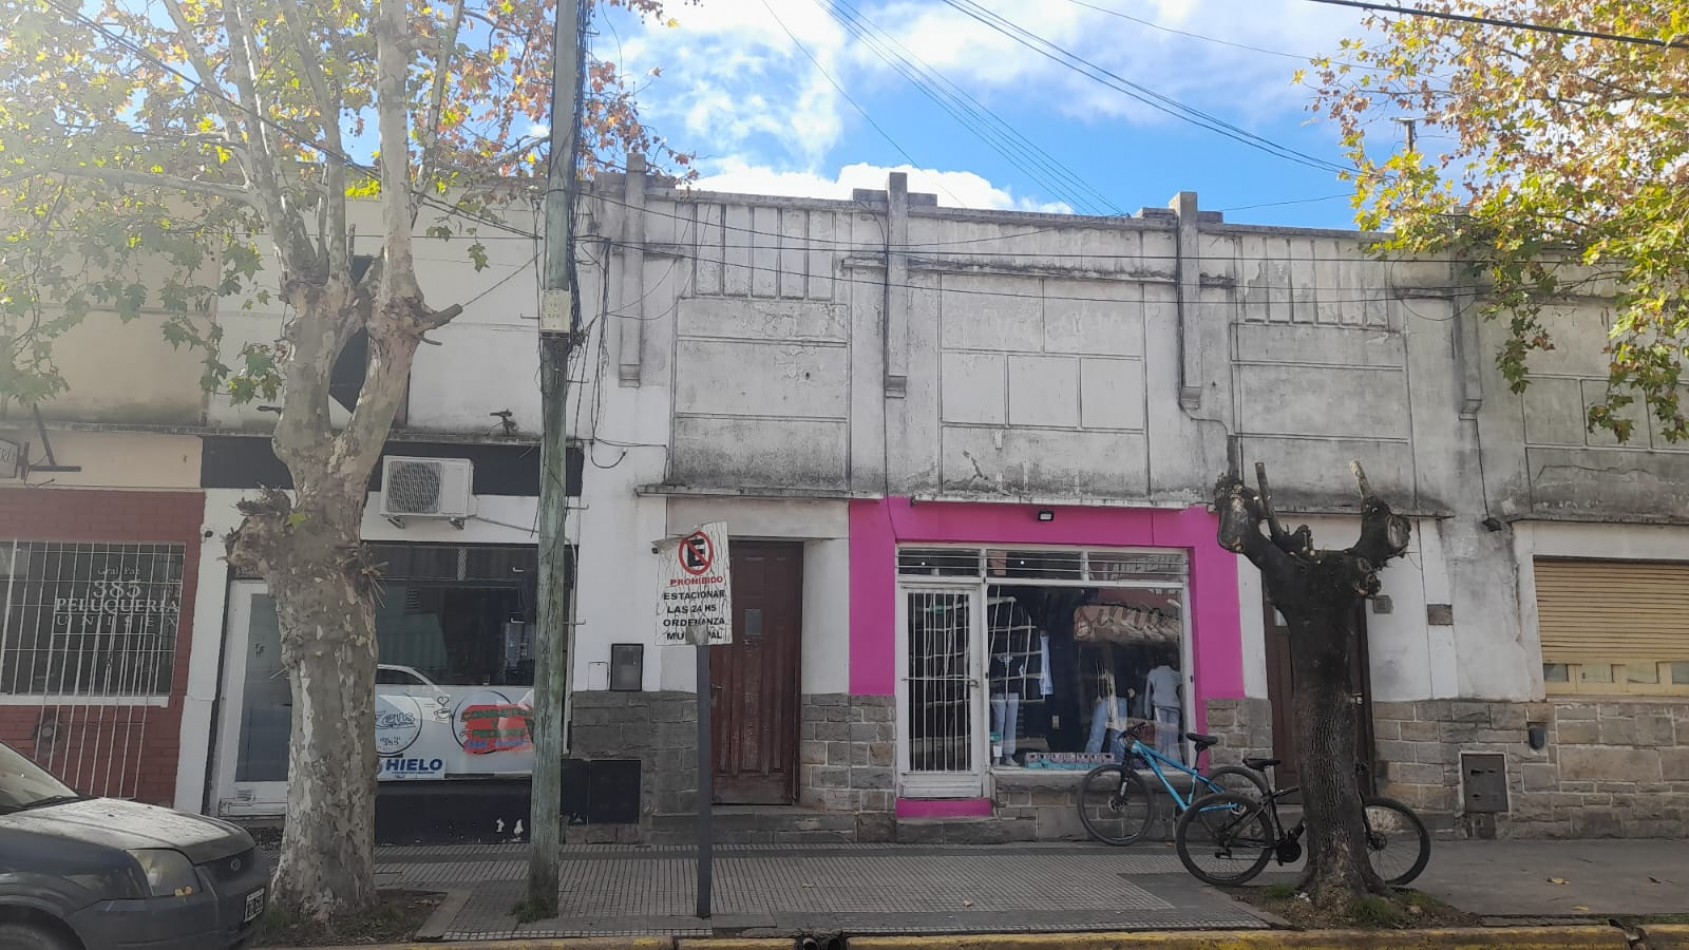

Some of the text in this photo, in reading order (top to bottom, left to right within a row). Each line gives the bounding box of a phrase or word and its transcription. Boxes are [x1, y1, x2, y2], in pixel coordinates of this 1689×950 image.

[670, 576, 723, 586] PROHIBIDO
[93, 580, 141, 598] 385
[663, 590, 725, 601] ESTACIONAR
[56, 598, 179, 614] PELUQUERIA
[667, 605, 688, 614] LAS
[691, 605, 702, 613] 24
[386, 758, 443, 771] HIELO
